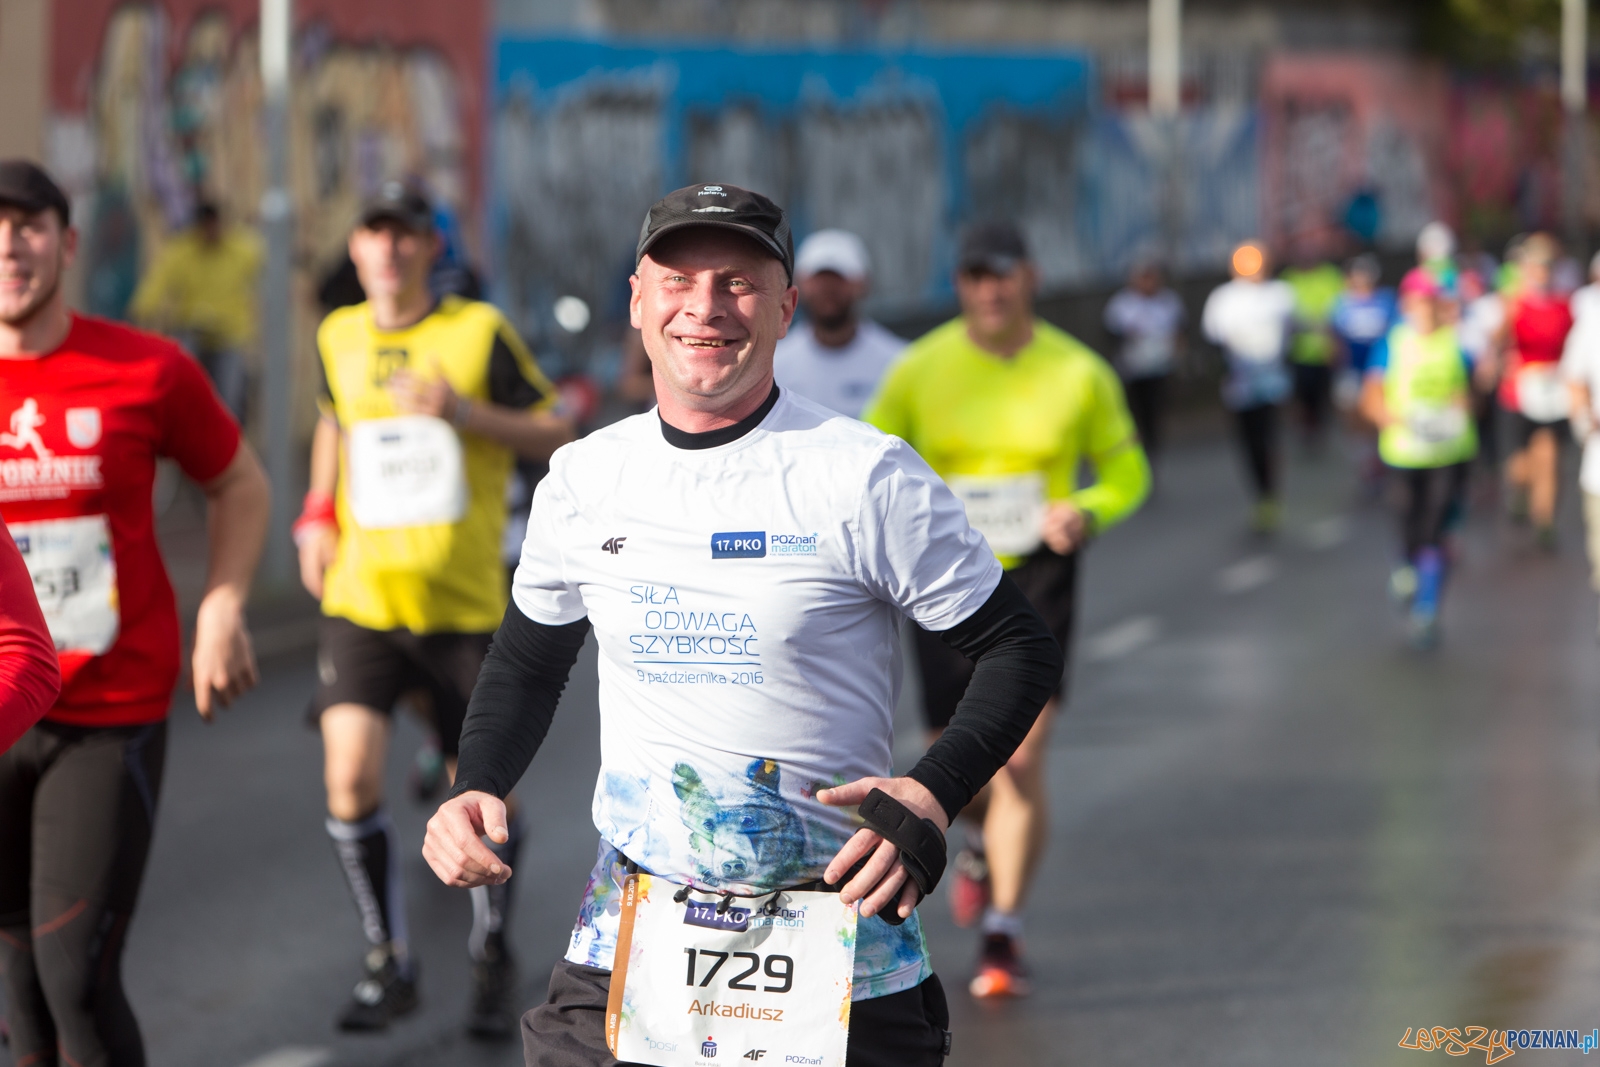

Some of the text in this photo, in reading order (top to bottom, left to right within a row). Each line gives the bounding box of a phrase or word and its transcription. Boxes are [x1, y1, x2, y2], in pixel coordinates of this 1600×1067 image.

[601, 536, 627, 555] 4F
[771, 534, 816, 544] POZnan
[771, 543, 817, 553] maraton
[630, 585, 680, 605] SIŁA
[644, 610, 757, 632] ODWAGA
[629, 634, 761, 657] SZYBKOŚĆ
[637, 669, 764, 685] 9 października 2016
[753, 916, 805, 928] maraton
[684, 947, 794, 993] 1729
[687, 999, 784, 1022] Arkadiusz
[743, 1049, 767, 1061] 4F
